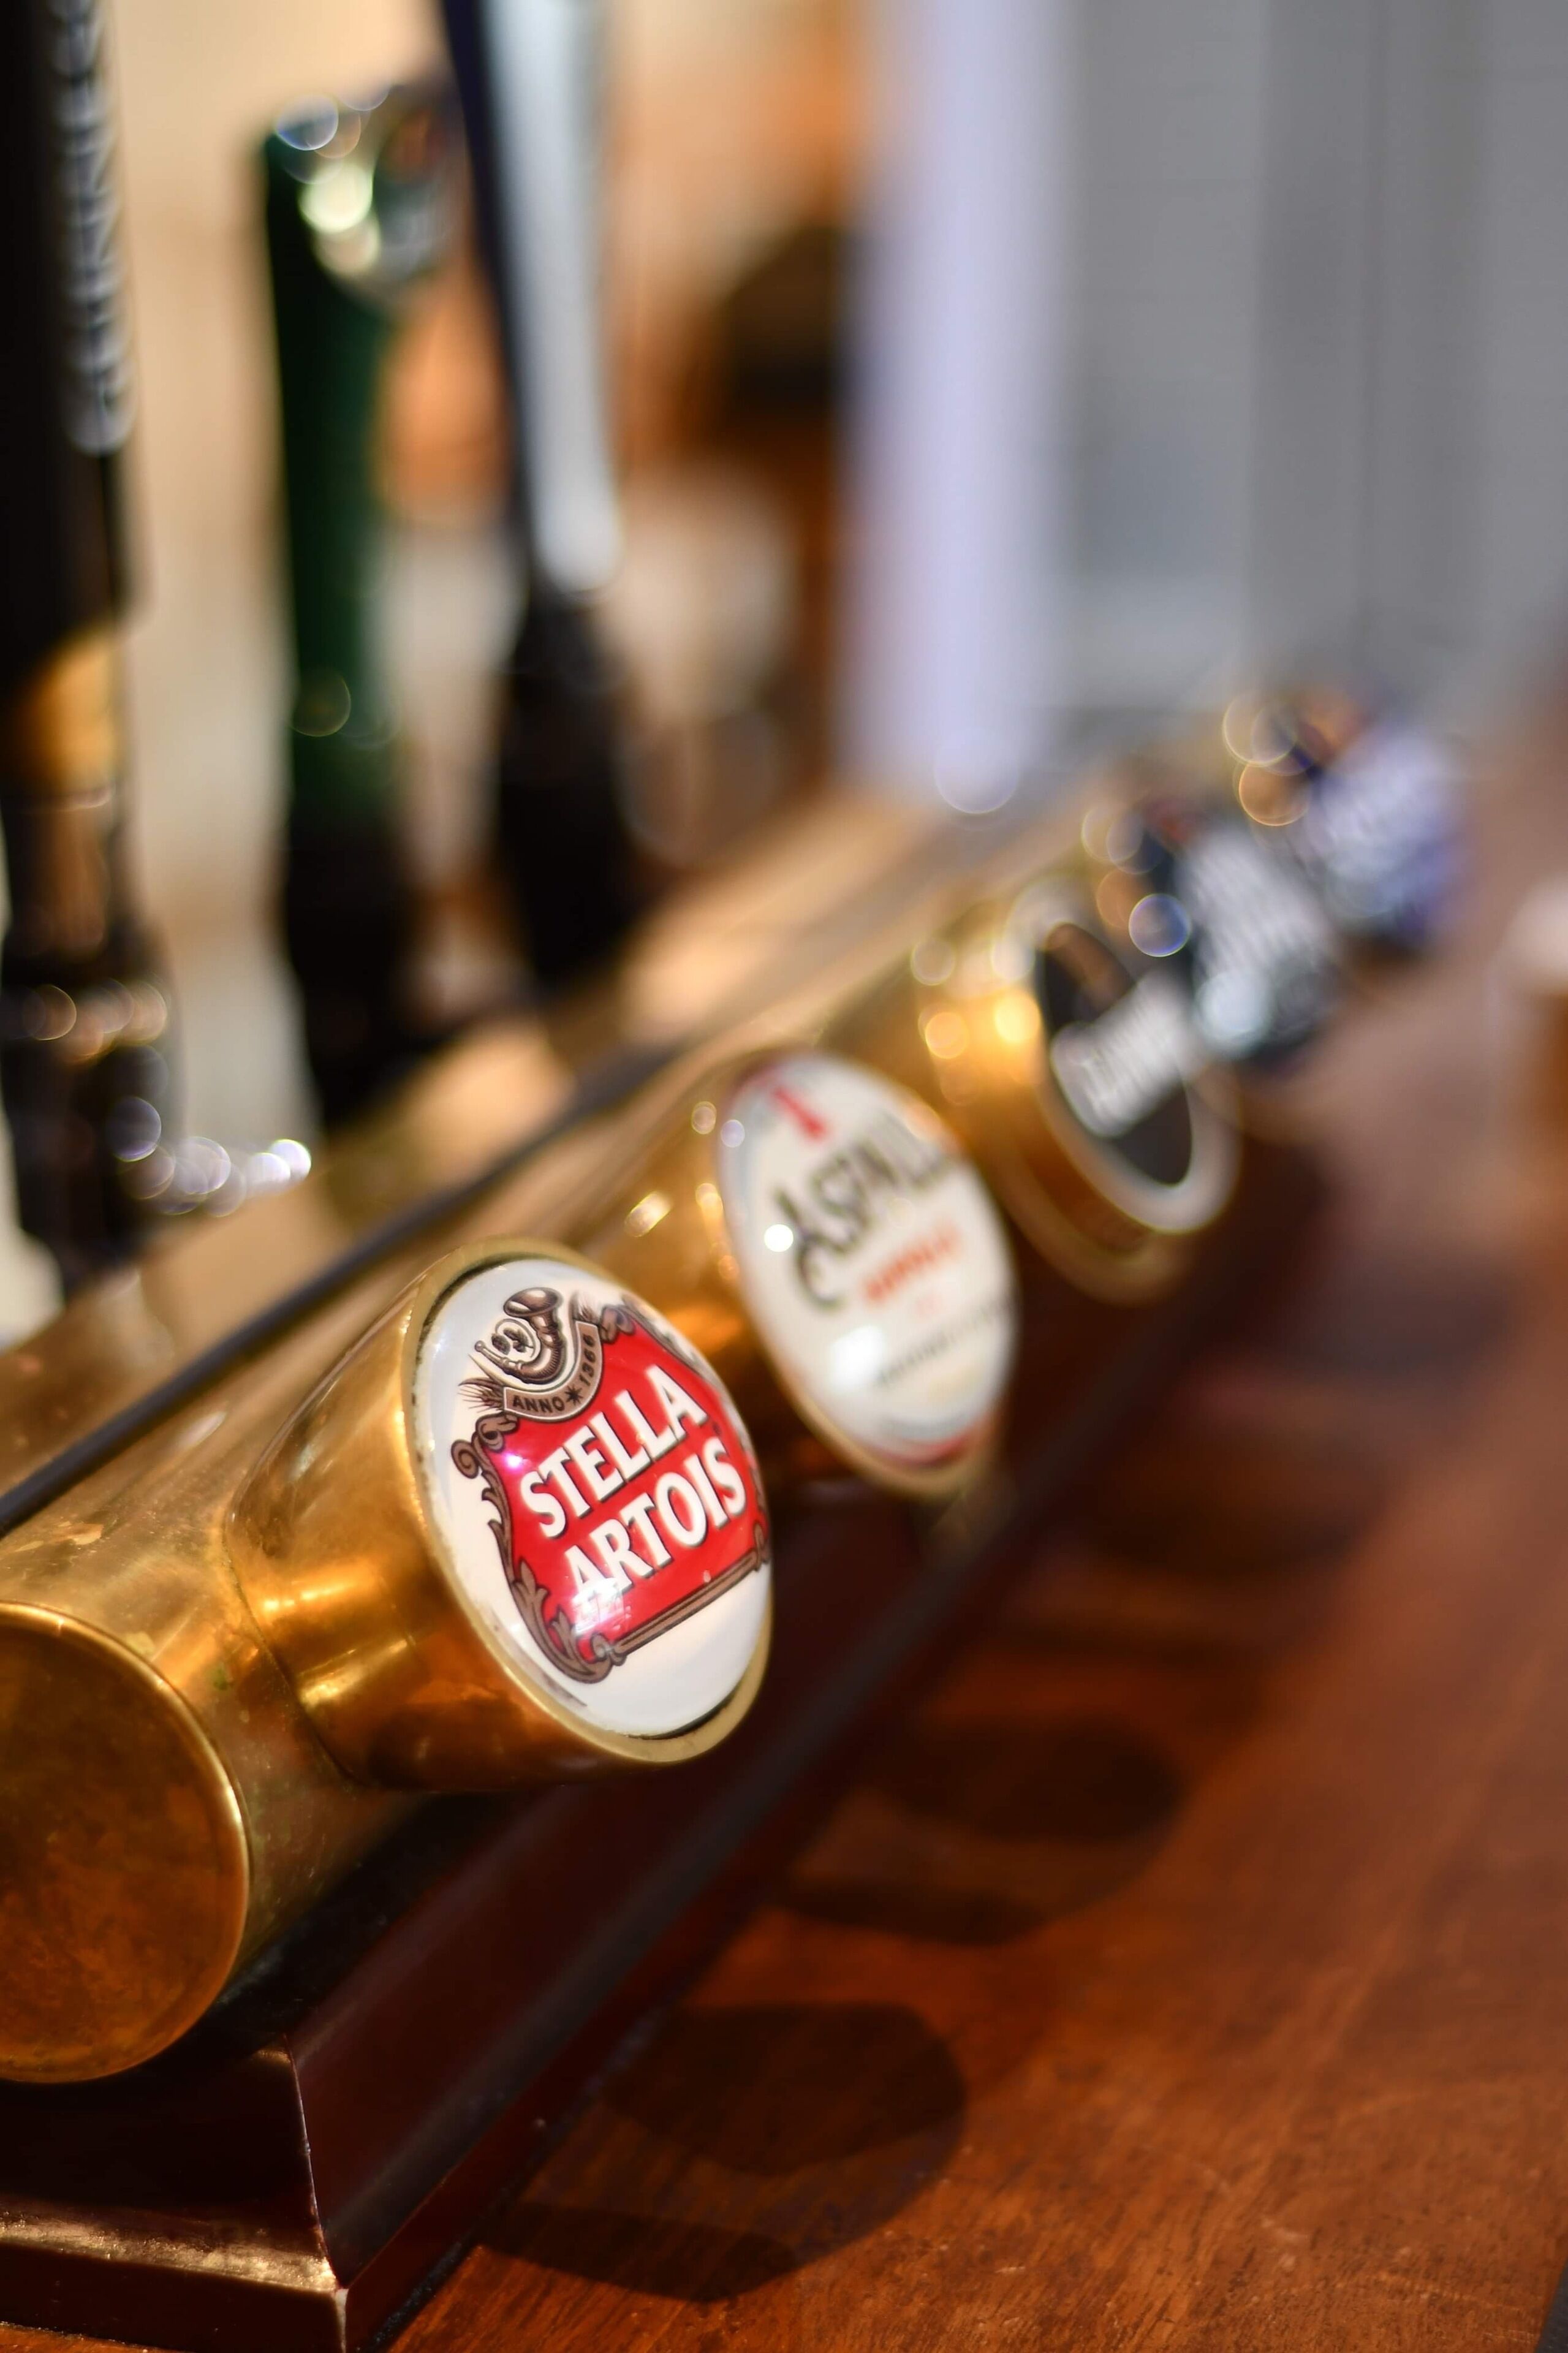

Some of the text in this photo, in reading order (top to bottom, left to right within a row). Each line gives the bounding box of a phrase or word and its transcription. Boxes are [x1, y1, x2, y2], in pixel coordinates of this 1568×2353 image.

[512, 1332, 596, 1413] ANNO 1366
[519, 1363, 708, 1539] STELLA
[564, 1436, 747, 1602] ARTOIS
